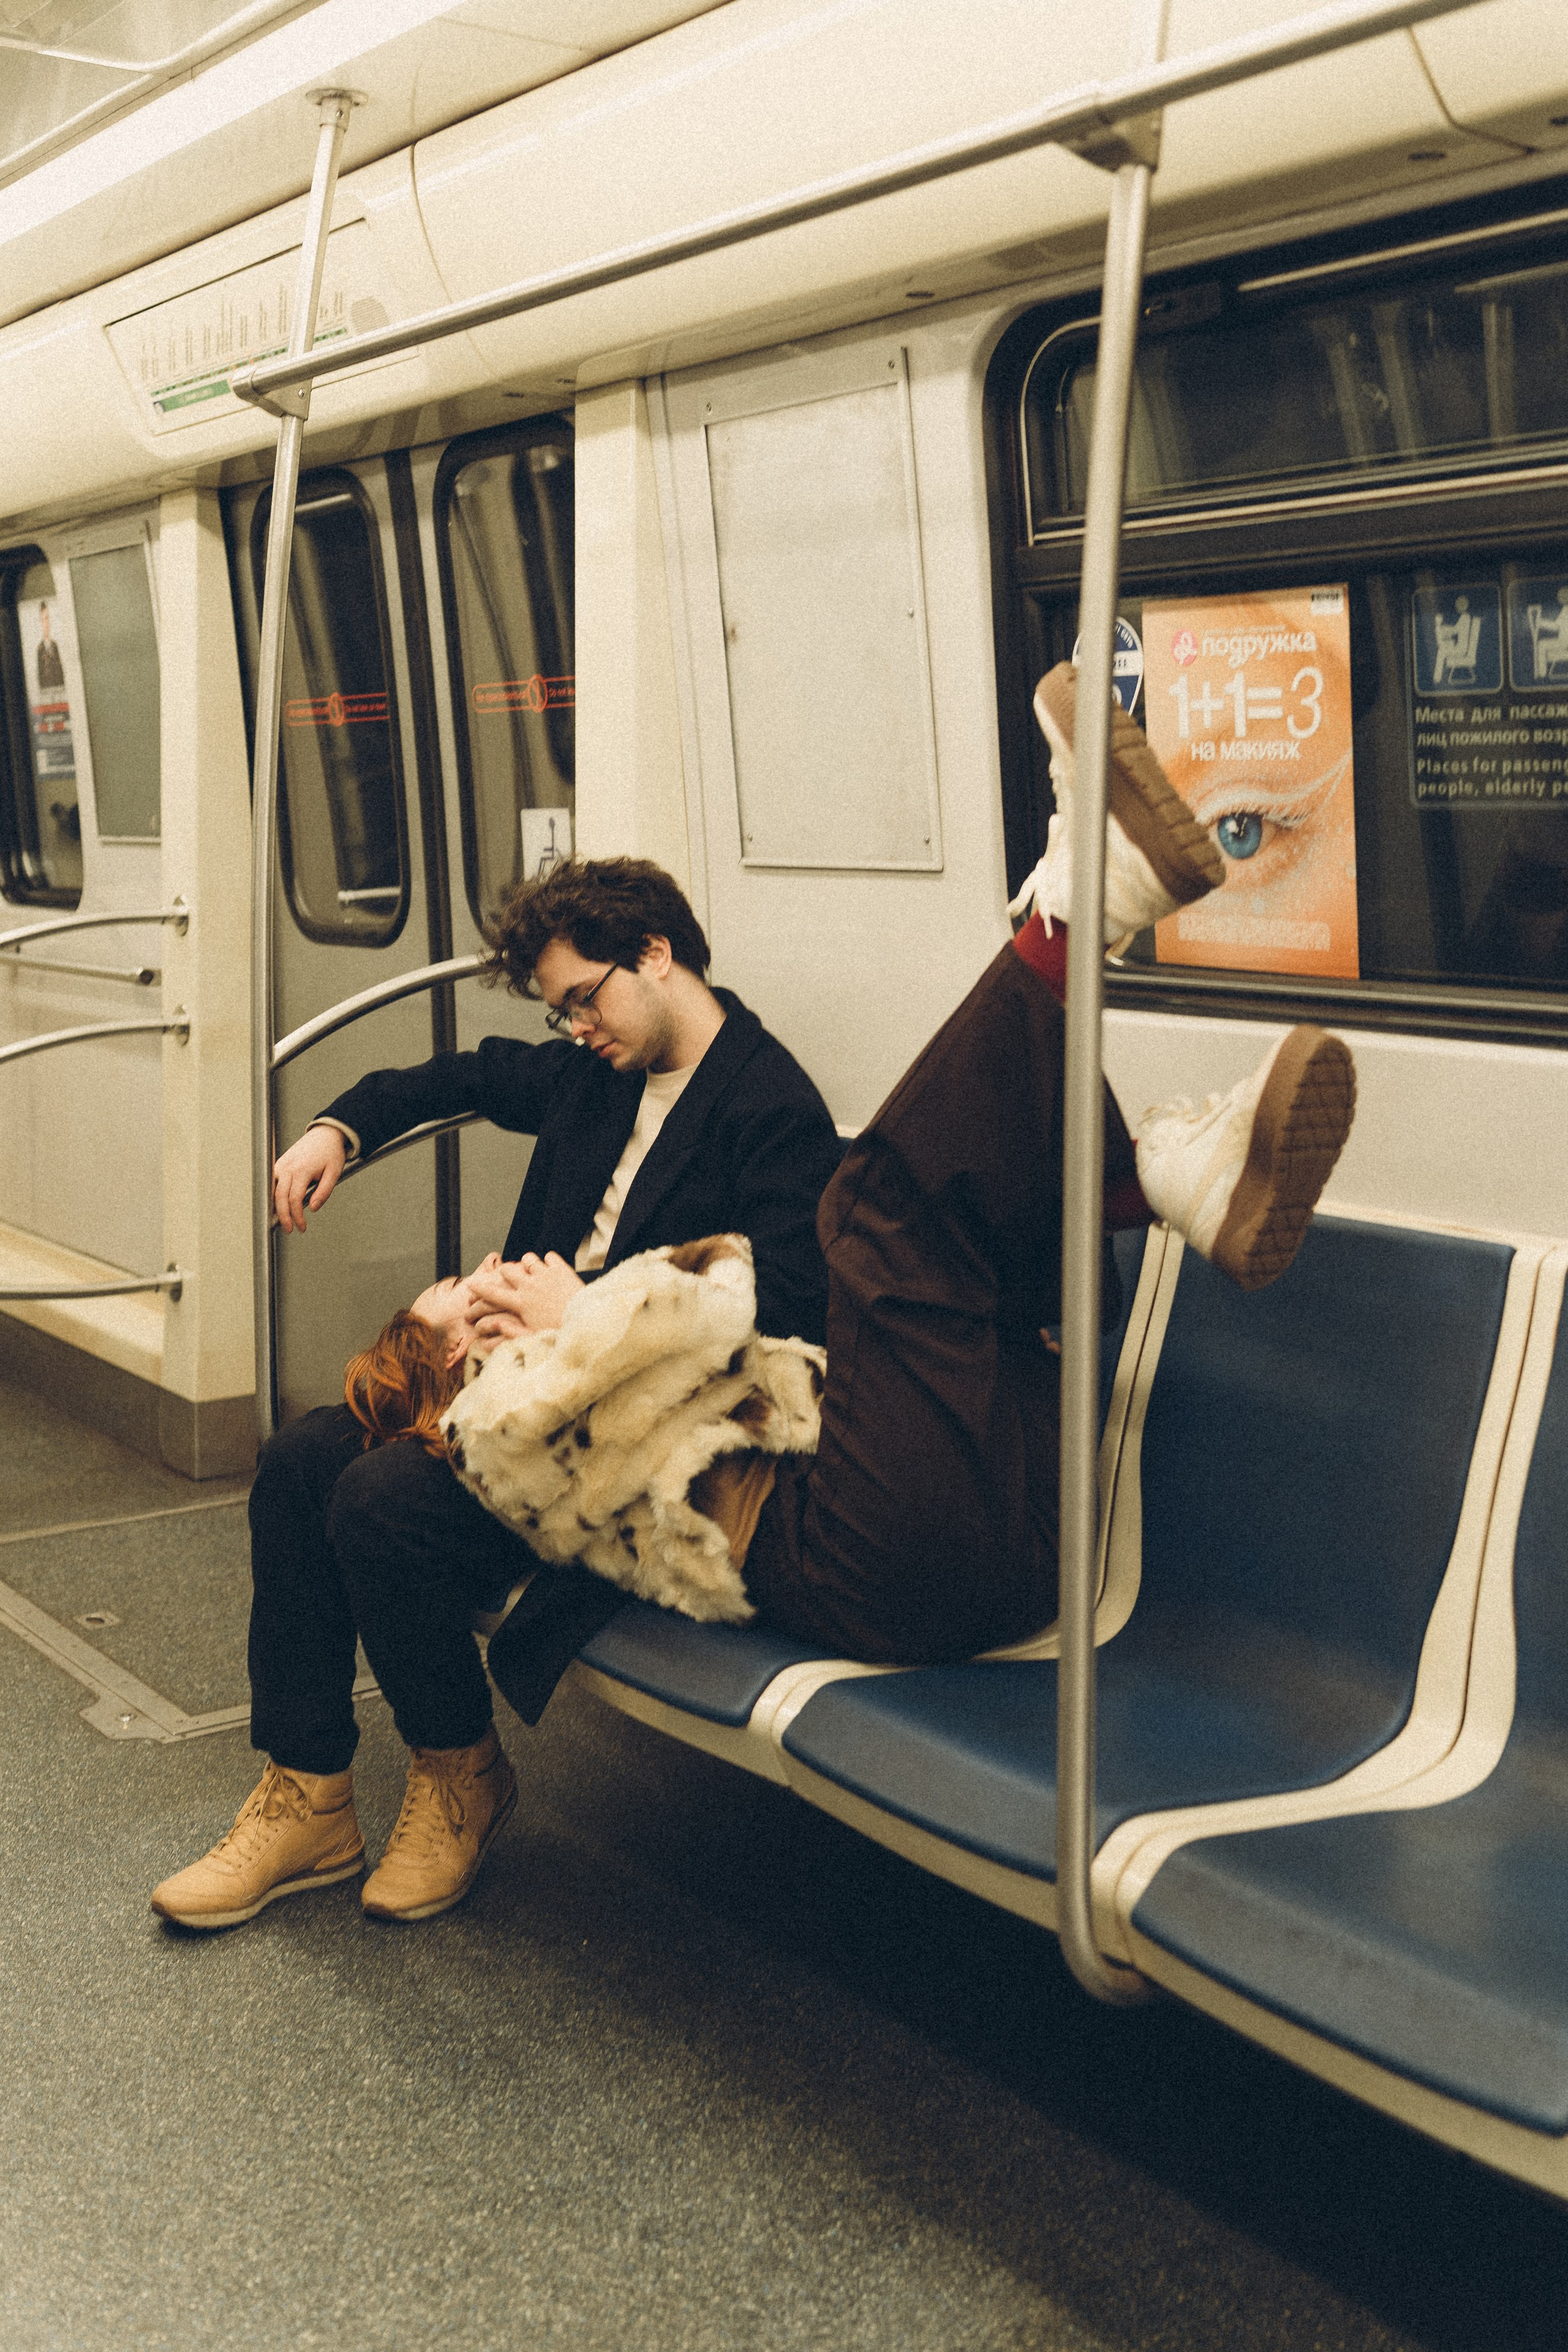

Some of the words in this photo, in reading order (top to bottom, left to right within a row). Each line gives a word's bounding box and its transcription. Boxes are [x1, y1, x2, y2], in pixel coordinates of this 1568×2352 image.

[1200, 631, 1317, 669] подружка
[1167, 665, 1324, 739] 1+1=3
[1415, 706, 1465, 724] Места
[1471, 706, 1502, 724] для
[1190, 739, 1216, 761] на
[1219, 739, 1302, 761] макияж
[1416, 732, 1447, 750] лиц
[1450, 729, 1531, 746] пожилого
[1417, 757, 1468, 774] Places
[1472, 755, 1498, 774] for
[1485, 777, 1546, 798] elderly
